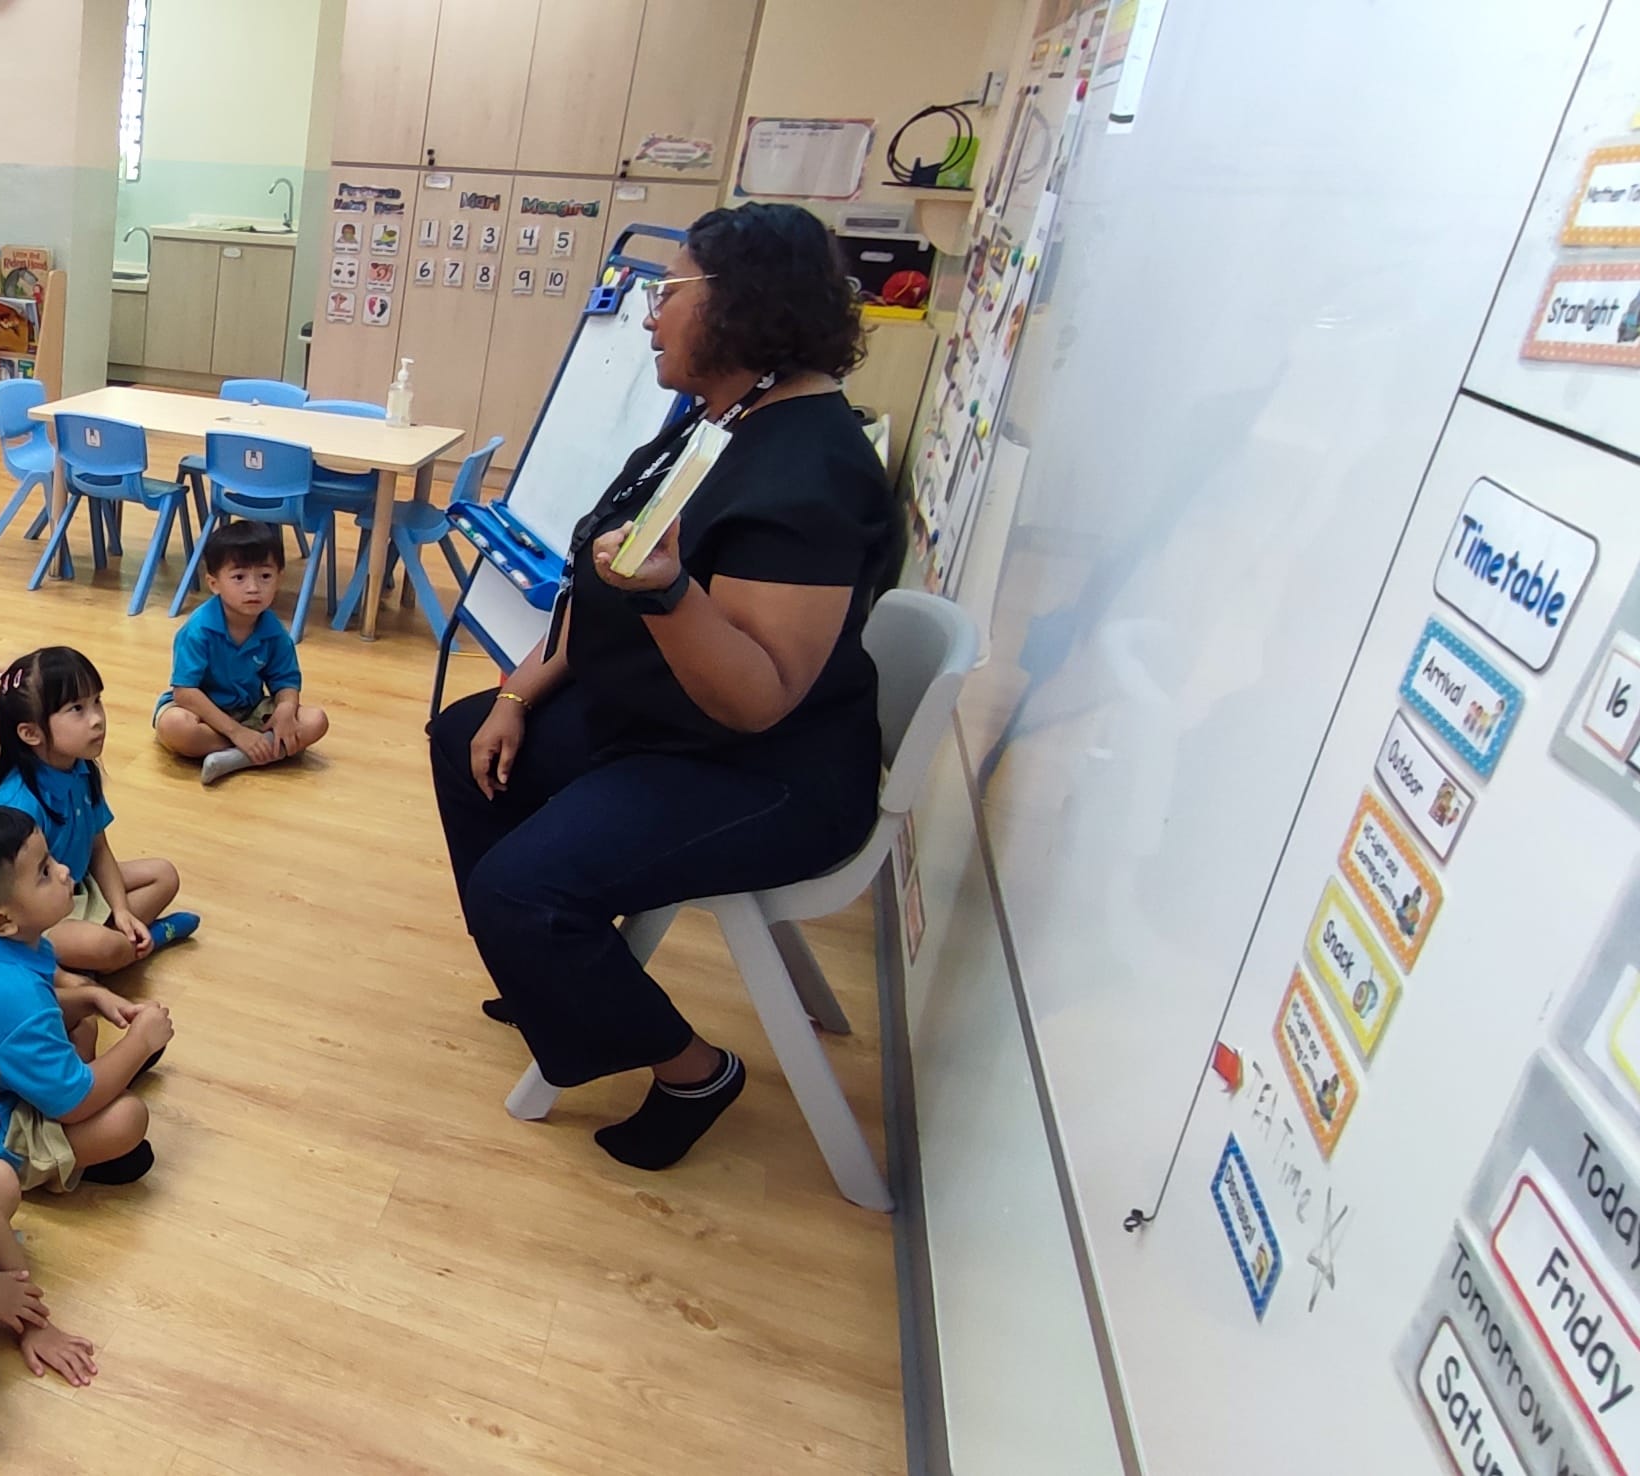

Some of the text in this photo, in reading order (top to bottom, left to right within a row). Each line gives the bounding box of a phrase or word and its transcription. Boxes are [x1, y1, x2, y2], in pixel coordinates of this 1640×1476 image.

[426, 221, 569, 248] 1 2 3 4 5
[419, 261, 564, 287] 6 7 8 9 10
[1547, 297, 1620, 331] Starlight
[1453, 514, 1566, 628] Timetable
[1421, 655, 1467, 707] Arrival
[1605, 677, 1632, 719] 16
[1387, 738, 1425, 798] Outdoor
[1323, 919, 1355, 980] Snack
[1449, 1243, 1554, 1446] Tomorrow
[1536, 1246, 1634, 1414] Friday
